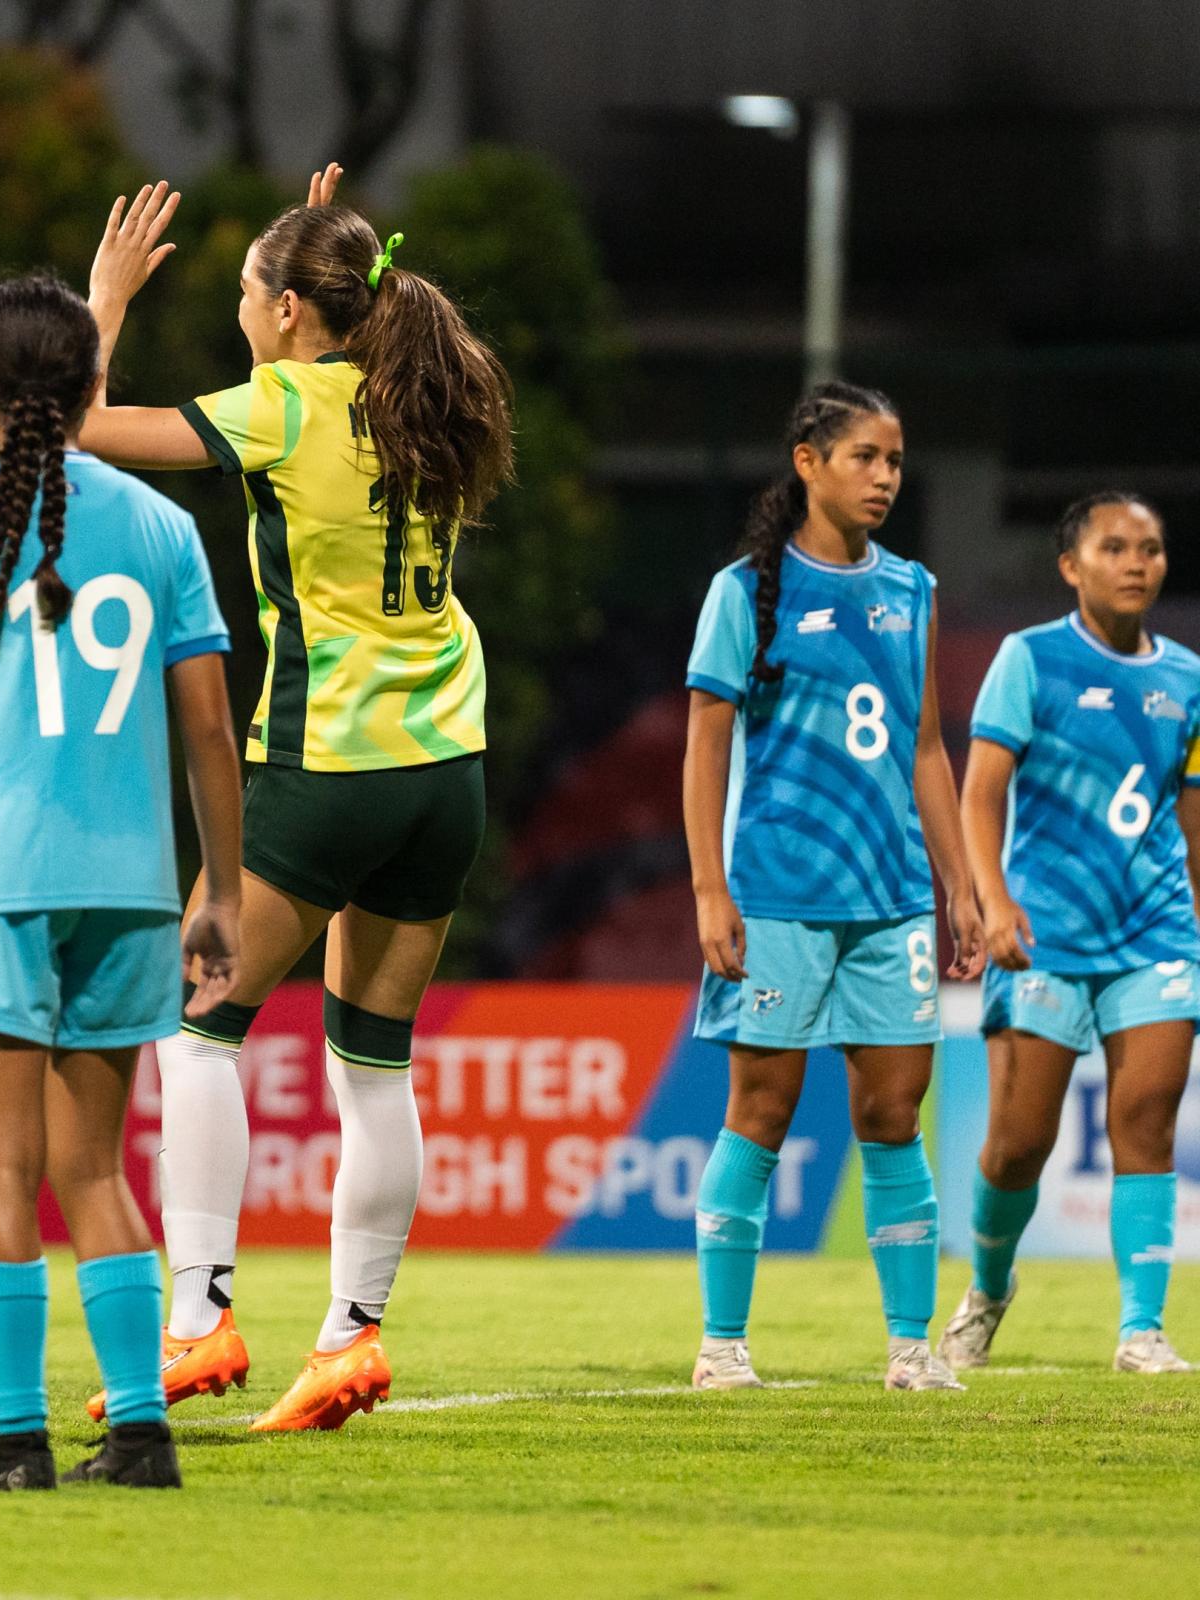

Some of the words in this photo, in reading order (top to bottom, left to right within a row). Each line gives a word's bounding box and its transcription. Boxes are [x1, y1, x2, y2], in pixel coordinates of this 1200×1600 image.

[8, 573, 155, 737] 19
[846, 683, 889, 760] 8
[1108, 765, 1151, 837] 6
[907, 930, 934, 992] 8
[543, 1134, 818, 1220] SPOT
